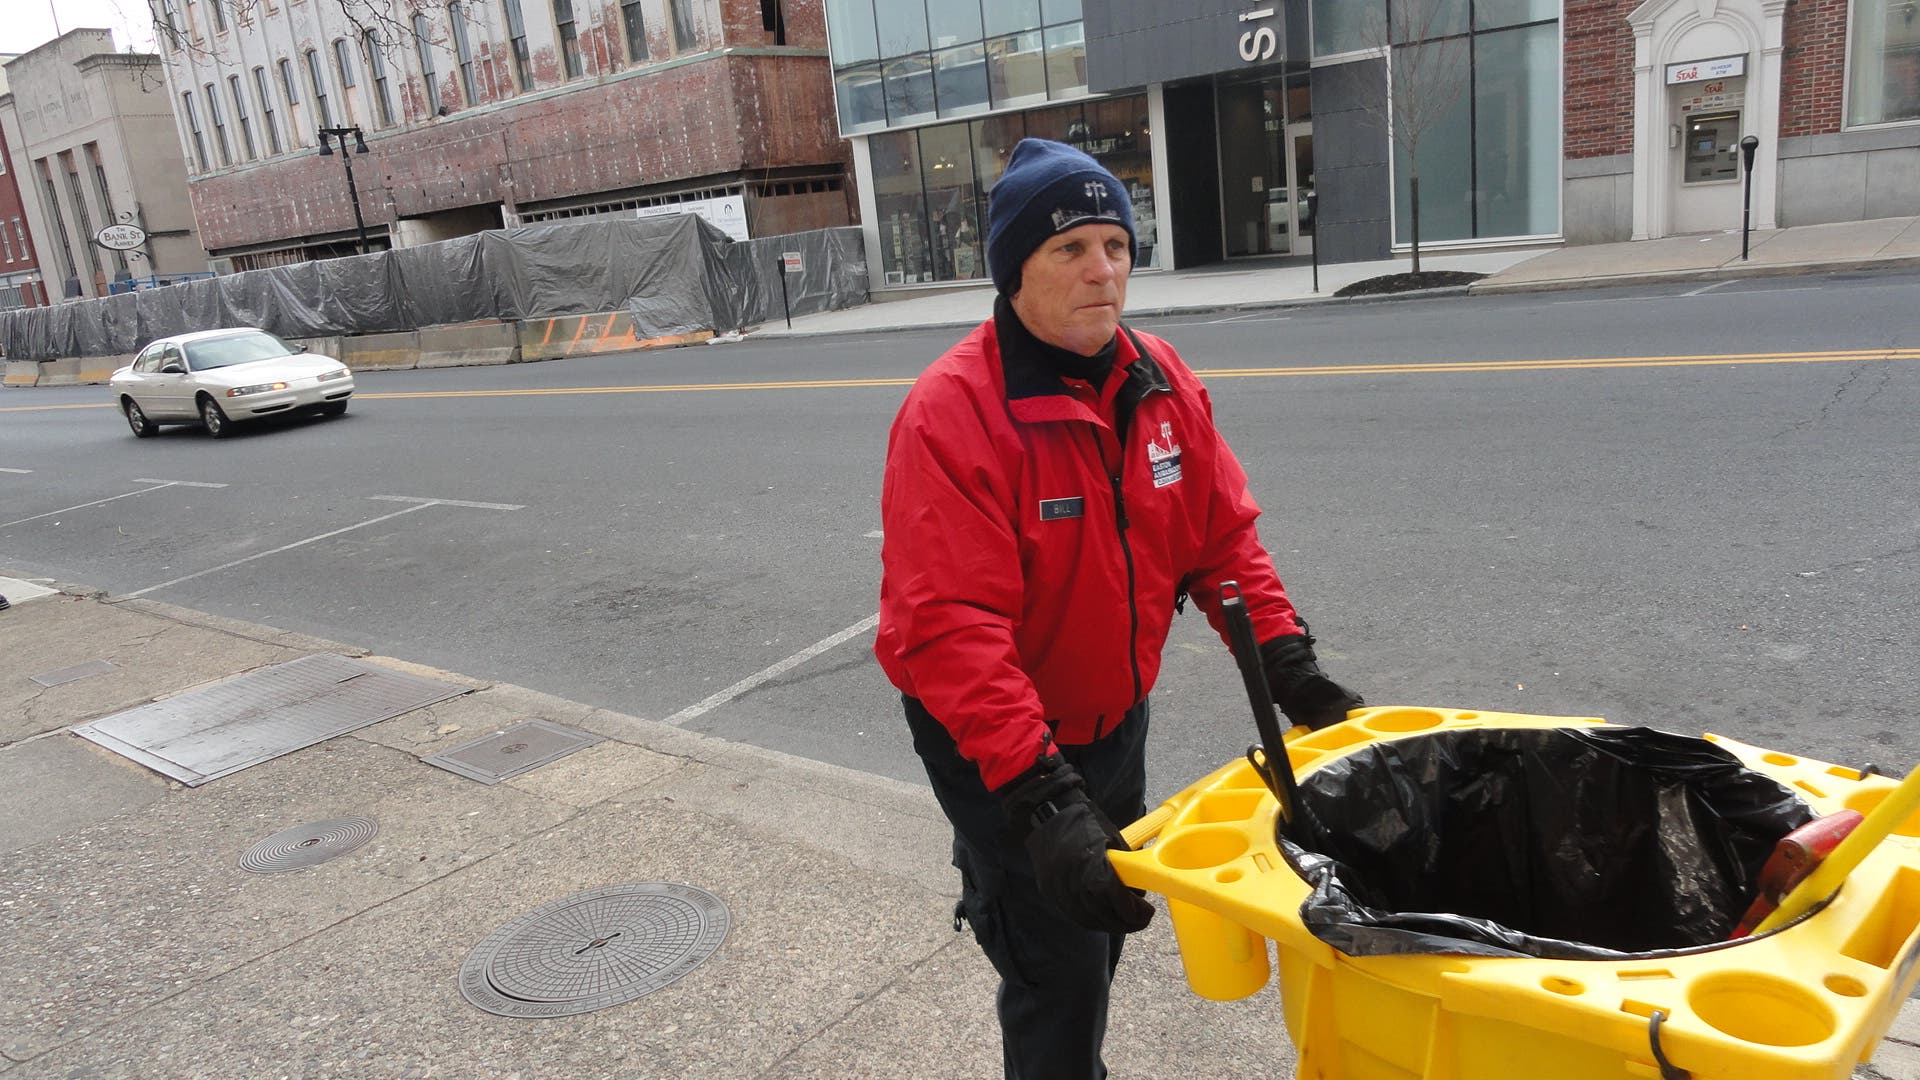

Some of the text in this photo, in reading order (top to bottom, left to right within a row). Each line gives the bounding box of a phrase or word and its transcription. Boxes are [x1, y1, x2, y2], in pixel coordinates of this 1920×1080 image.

[1239, 1, 1276, 61] Si
[1676, 69, 1698, 80] STAR
[1704, 84, 1723, 94] STAR
[104, 232, 128, 241] BANK
[1054, 504, 1071, 514] BILL
